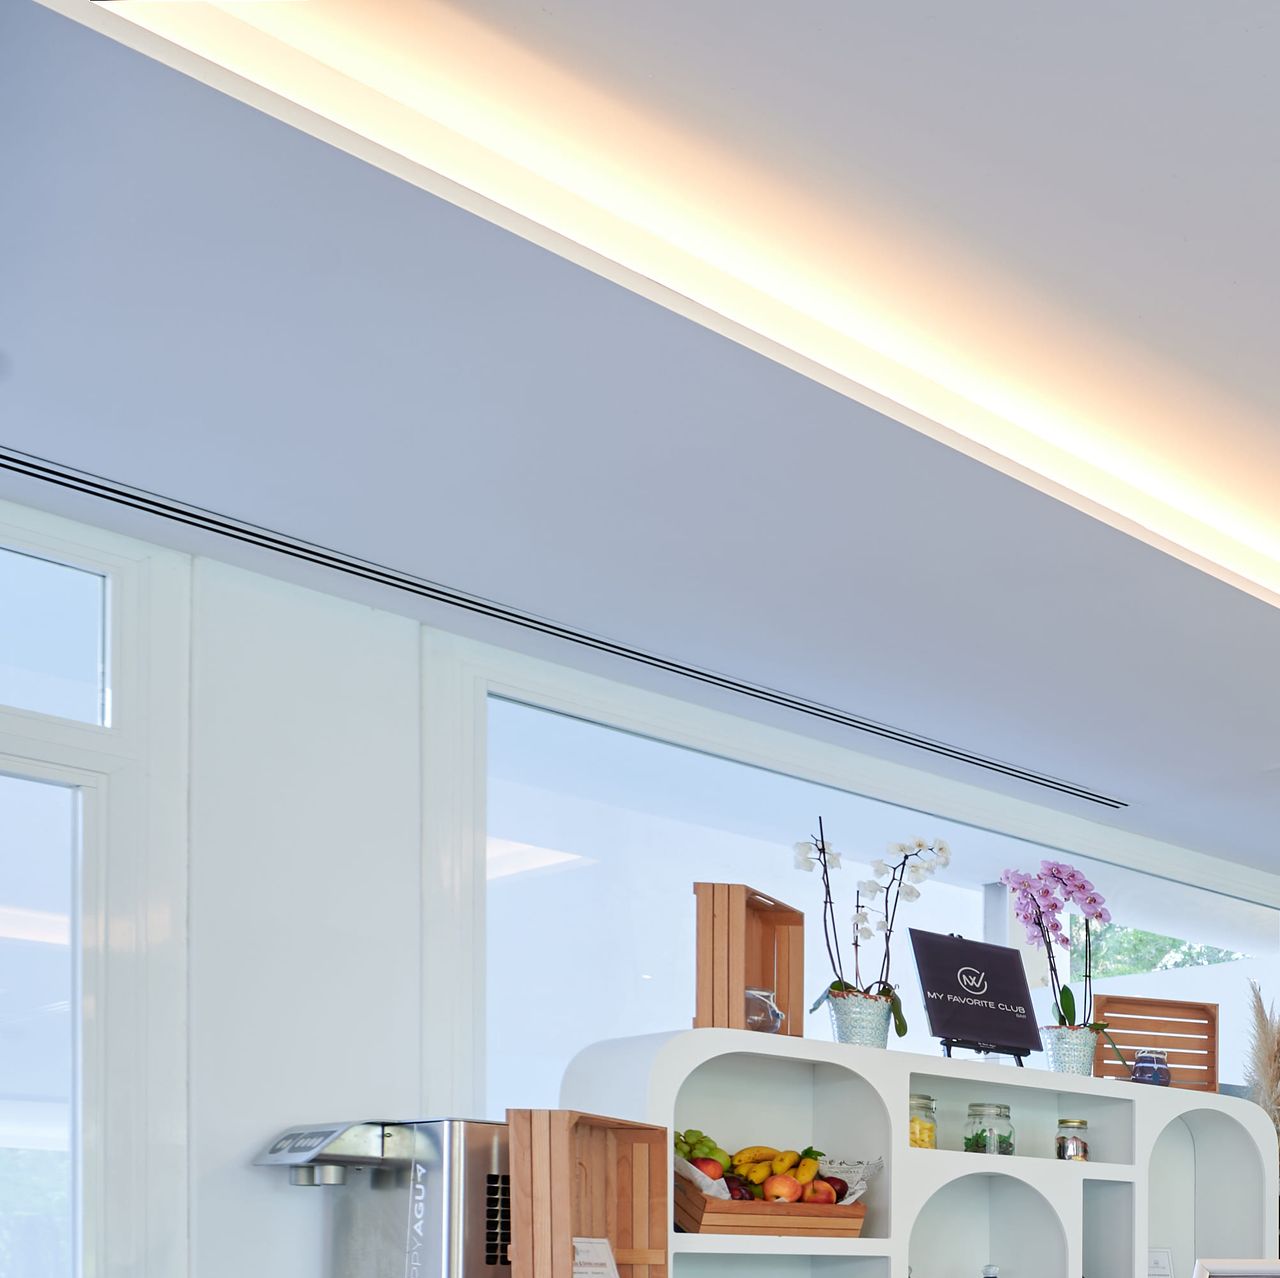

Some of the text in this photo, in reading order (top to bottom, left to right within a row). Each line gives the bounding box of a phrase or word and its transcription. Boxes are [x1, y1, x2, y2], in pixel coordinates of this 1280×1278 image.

[926, 991, 1026, 1014] MY FAVORITE CLUB
